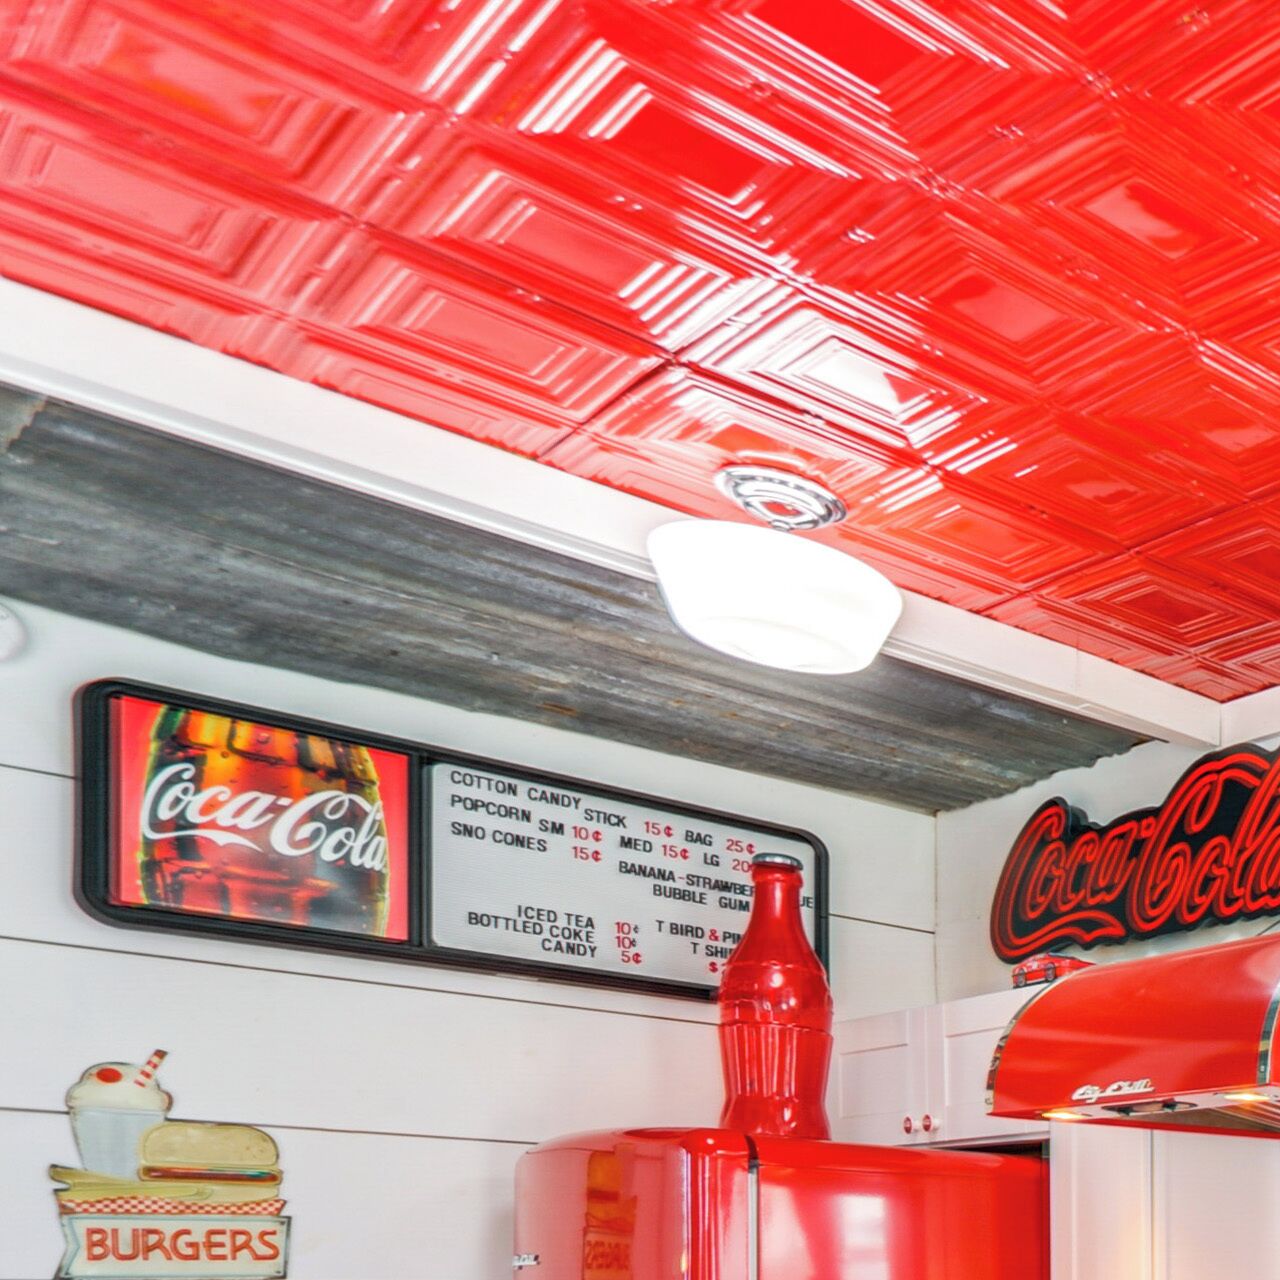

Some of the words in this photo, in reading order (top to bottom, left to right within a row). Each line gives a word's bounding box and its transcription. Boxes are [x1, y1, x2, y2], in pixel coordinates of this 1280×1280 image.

[140, 762, 387, 872] Coca-Cola
[450, 770, 518, 796] COTTON
[527, 787, 581, 810] CANDY
[584, 808, 627, 828] STICK
[685, 829, 712, 846] BAG
[451, 794, 531, 823] POPCORN
[539, 818, 565, 836] SM
[620, 835, 653, 853] MED
[703, 853, 720, 867] LG
[451, 821, 486, 840] SNO
[492, 829, 548, 852] CONES
[653, 884, 707, 905] BUBBLE
[719, 896, 750, 912] GUM
[468, 911, 544, 937] BOTTLED
[549, 924, 595, 944] COKE
[517, 905, 557, 924] ICED
[565, 912, 595, 930] TEA
[656, 920, 665, 933] T
[669, 923, 705, 940] BIRD
[708, 928, 720, 942] &
[541, 937, 597, 959] CANDY
[690, 941, 700, 955] T
[85, 1227, 280, 1261] BURGERS
